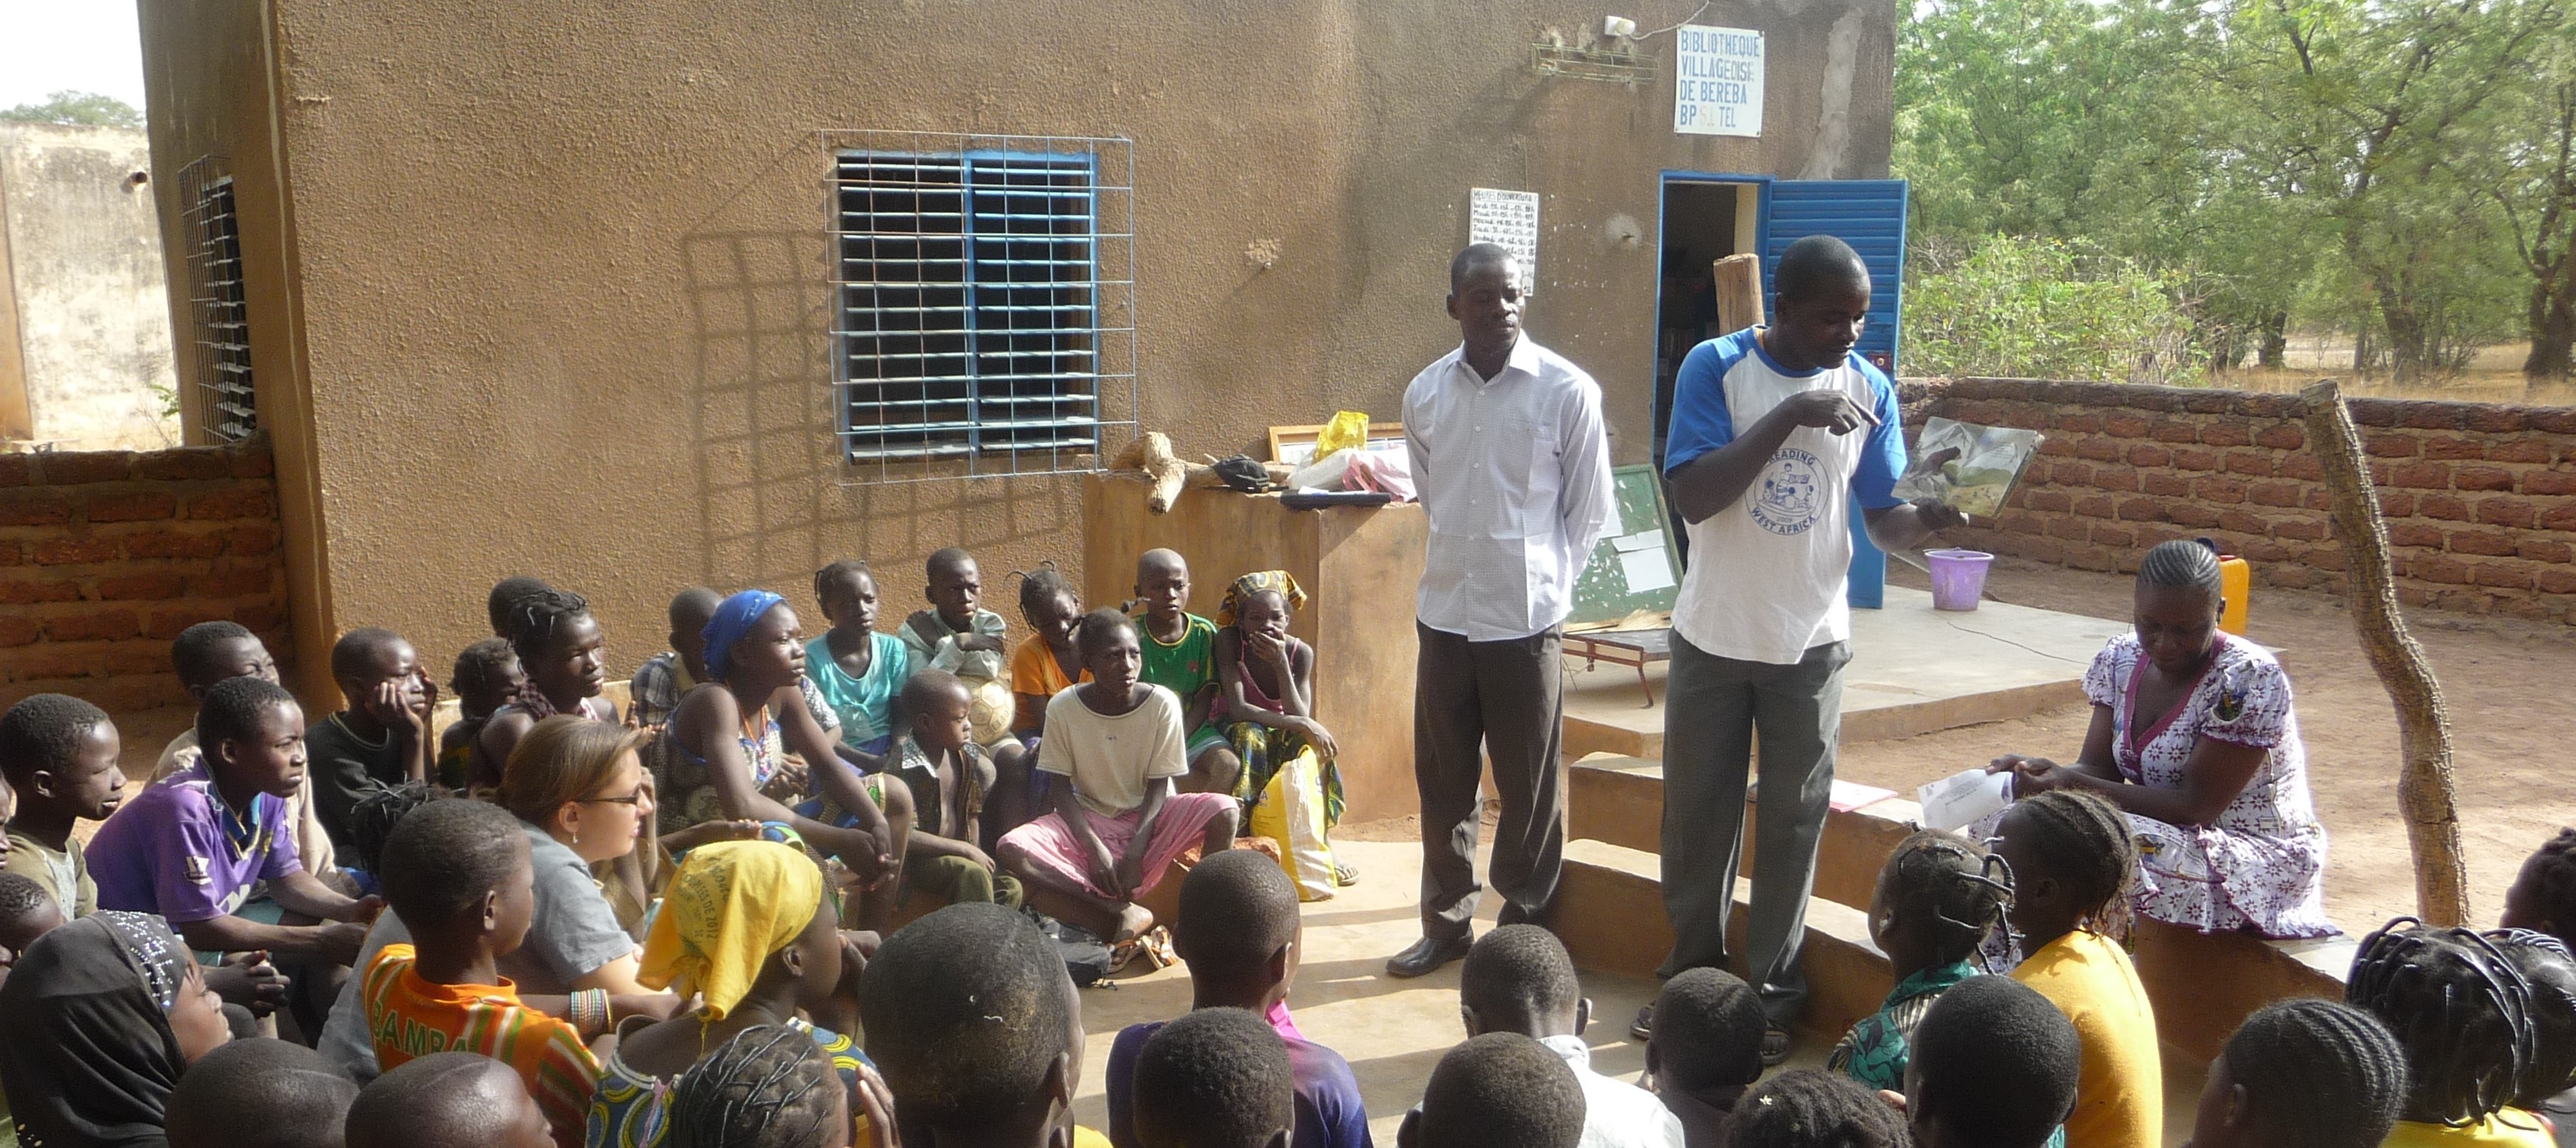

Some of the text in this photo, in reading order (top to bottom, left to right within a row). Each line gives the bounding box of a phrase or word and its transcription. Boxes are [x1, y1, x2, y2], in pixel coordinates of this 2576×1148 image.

[1681, 30, 1760, 57] BIBLIOTHEQUE
[1681, 55, 1755, 82] VILLAGEOISE
[1680, 80, 1747, 104] DE BEREBA
[1680, 104, 1697, 125] BP
[1719, 107, 1736, 128] TEL
[1752, 506, 1817, 534] WEST AFRICA
